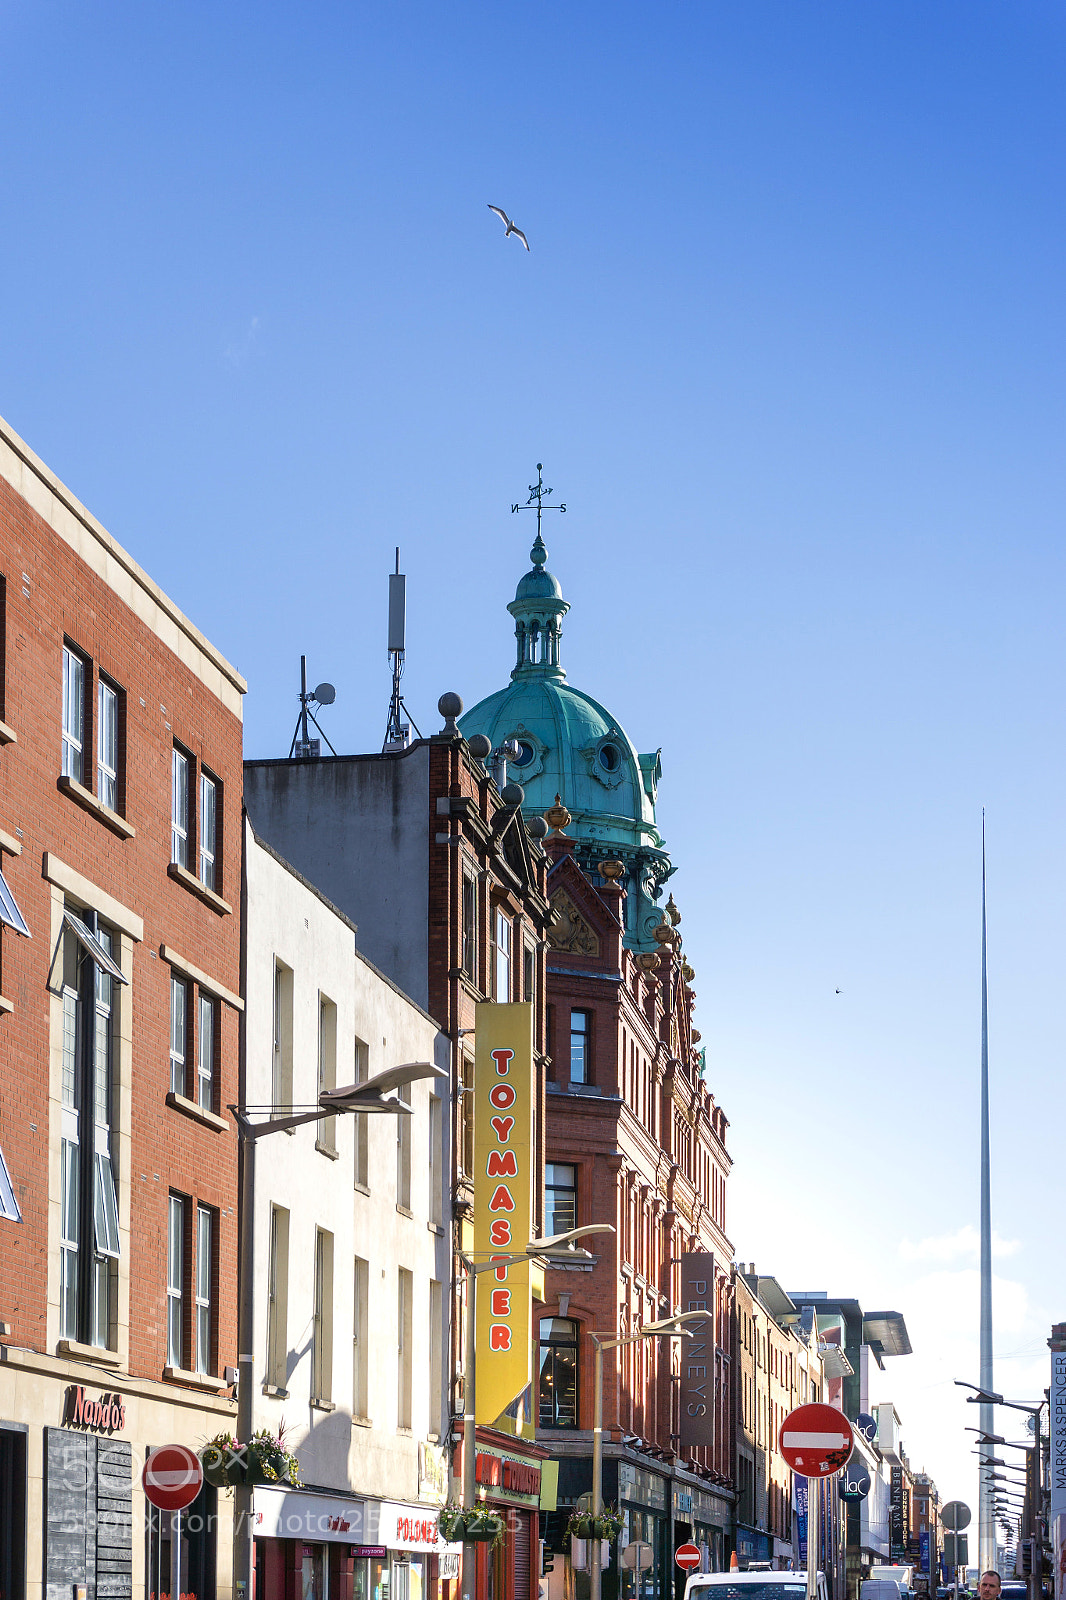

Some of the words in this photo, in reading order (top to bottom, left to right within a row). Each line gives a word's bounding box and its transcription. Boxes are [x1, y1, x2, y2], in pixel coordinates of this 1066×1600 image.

[486, 1047, 519, 1352] TOYMASTER
[687, 1280, 707, 1417] PENNEYS
[72, 1385, 126, 1431] Nando's
[1055, 1357, 1066, 1424] SPENCER
[1055, 1425, 1066, 1437] &
[1055, 1439, 1066, 1489] MARKS
[892, 1466, 900, 1528] EBENHAMS
